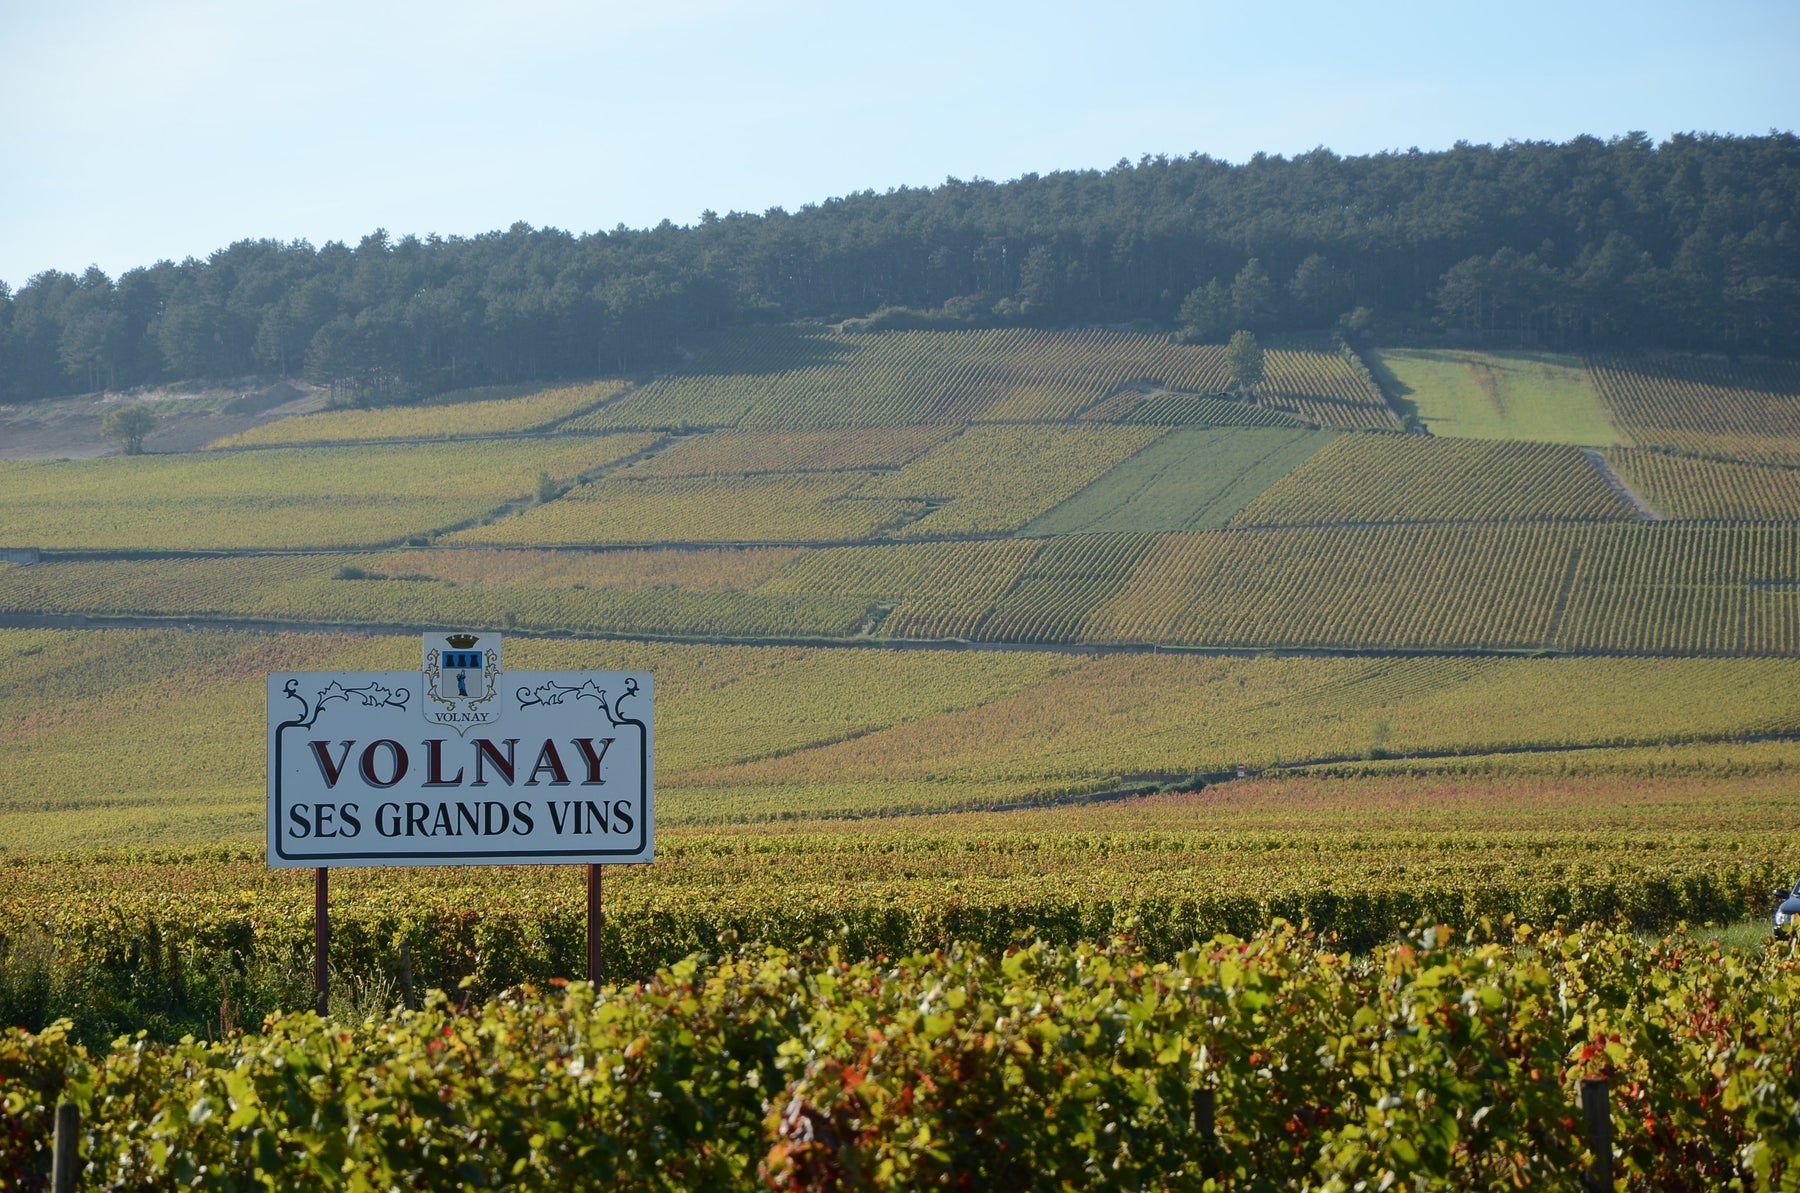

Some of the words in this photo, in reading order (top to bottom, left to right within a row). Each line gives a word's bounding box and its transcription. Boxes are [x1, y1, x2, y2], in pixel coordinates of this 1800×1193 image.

[435, 712, 490, 722] VOLNAY
[307, 737, 616, 789] VOLNAY
[287, 802, 362, 839] SES
[374, 800, 535, 838] GRANDS
[546, 799, 635, 836] VINS
